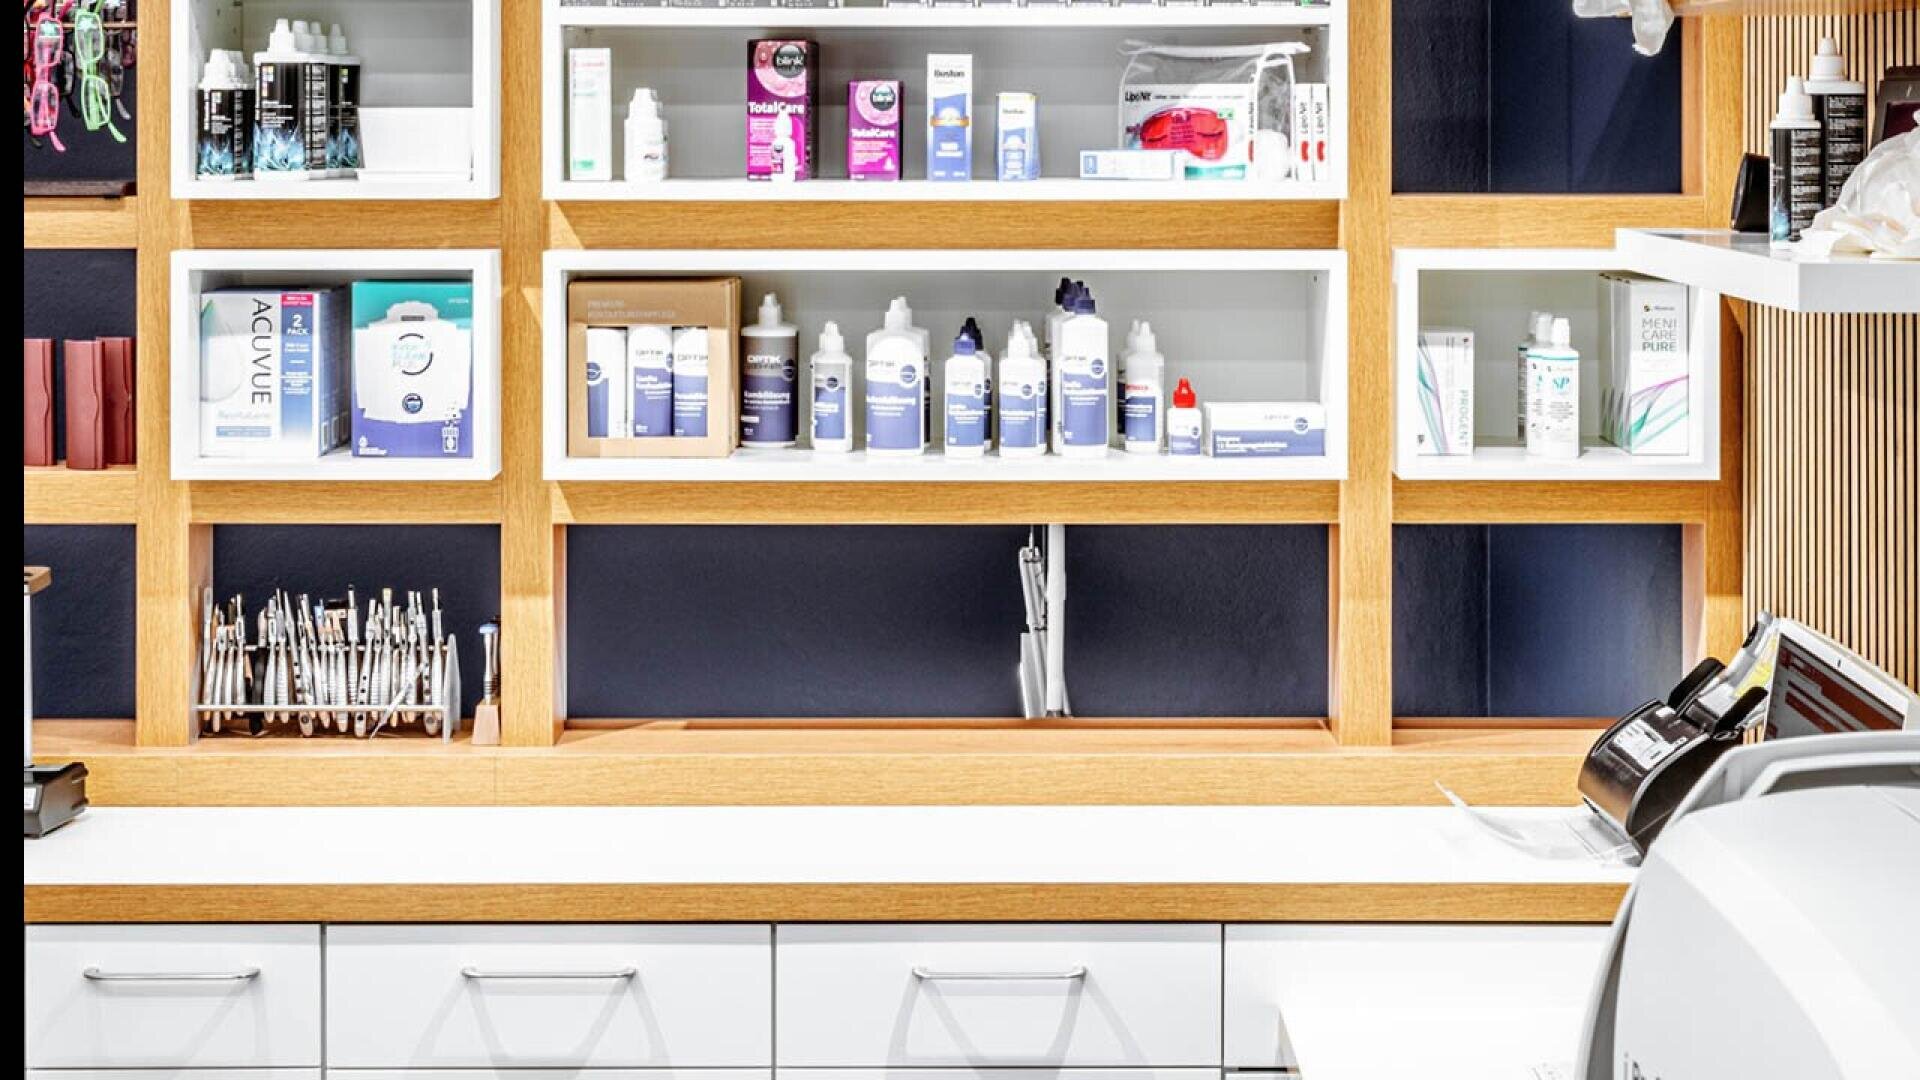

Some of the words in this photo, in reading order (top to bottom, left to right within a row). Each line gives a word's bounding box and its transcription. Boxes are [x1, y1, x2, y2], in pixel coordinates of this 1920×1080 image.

[748, 101, 805, 114] TotalCare
[851, 128, 896, 138] TotalCare
[292, 314, 303, 328] 2
[1642, 318, 1677, 328] MENI
[1642, 329, 1677, 340] CARE
[252, 298, 272, 404] ACUVUE
[1642, 341, 1677, 352] PURE
[1459, 389, 1469, 447] PROGENT
